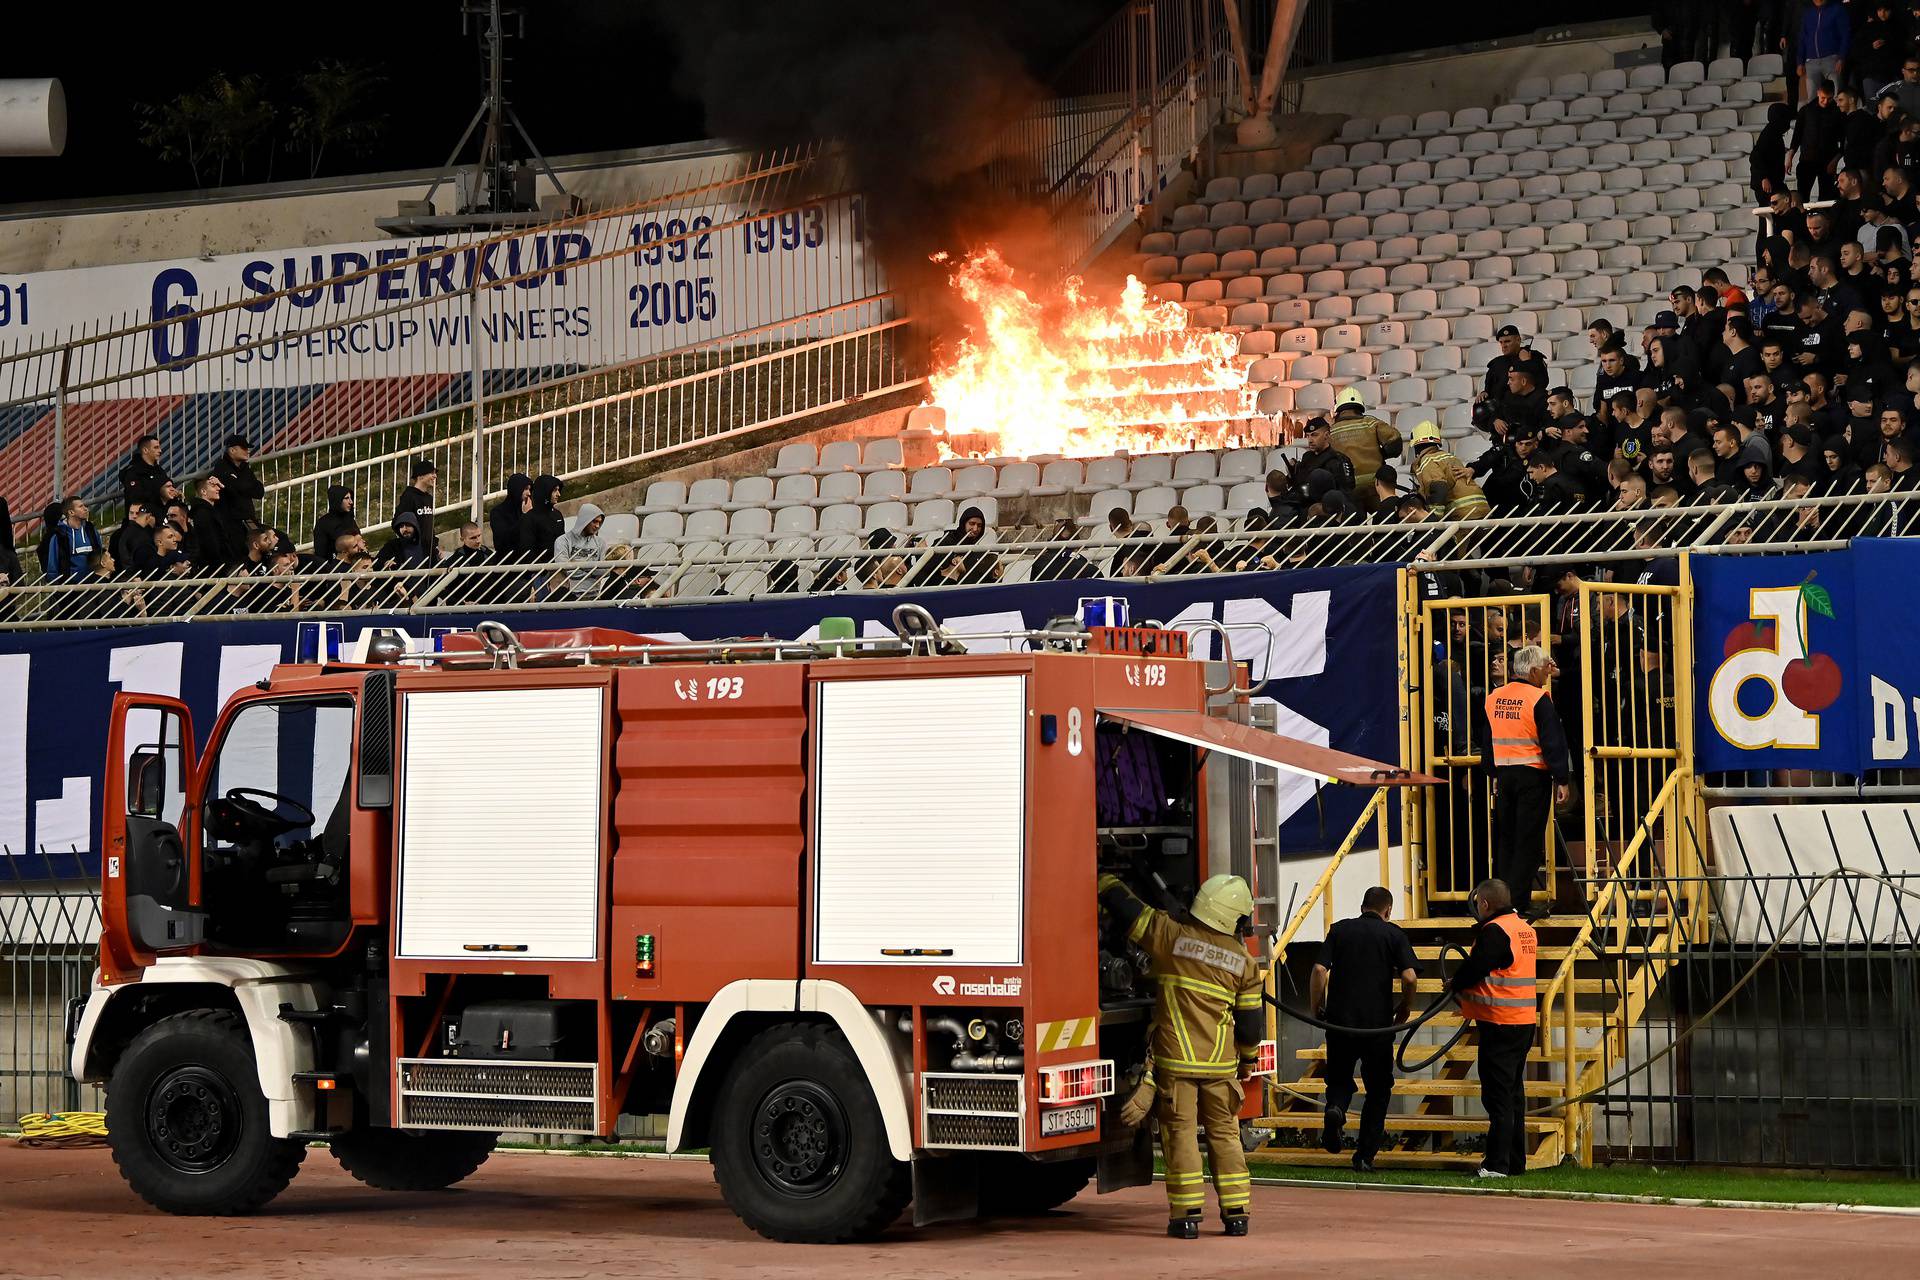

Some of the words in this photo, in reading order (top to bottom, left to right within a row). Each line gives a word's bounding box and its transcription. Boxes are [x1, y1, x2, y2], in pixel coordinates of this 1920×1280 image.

[630, 215, 713, 267] 1992
[738, 205, 823, 254] 1993
[241, 233, 593, 313] SUPERKUP
[629, 277, 716, 328] 2005
[152, 268, 198, 371] 6
[234, 319, 419, 364] SUPERCUP
[428, 306, 592, 347] WINNERS
[706, 677, 744, 699] 193
[1144, 664, 1166, 686] 193
[1494, 711, 1504, 719] PIT
[1496, 698, 1523, 706] REDAR
[1067, 707, 1082, 756] 8
[1180, 942, 1204, 955] JVP
[1205, 949, 1242, 968] SPLIT
[960, 976, 1022, 996] rosenbauer
[1048, 1113, 1058, 1130] ST
